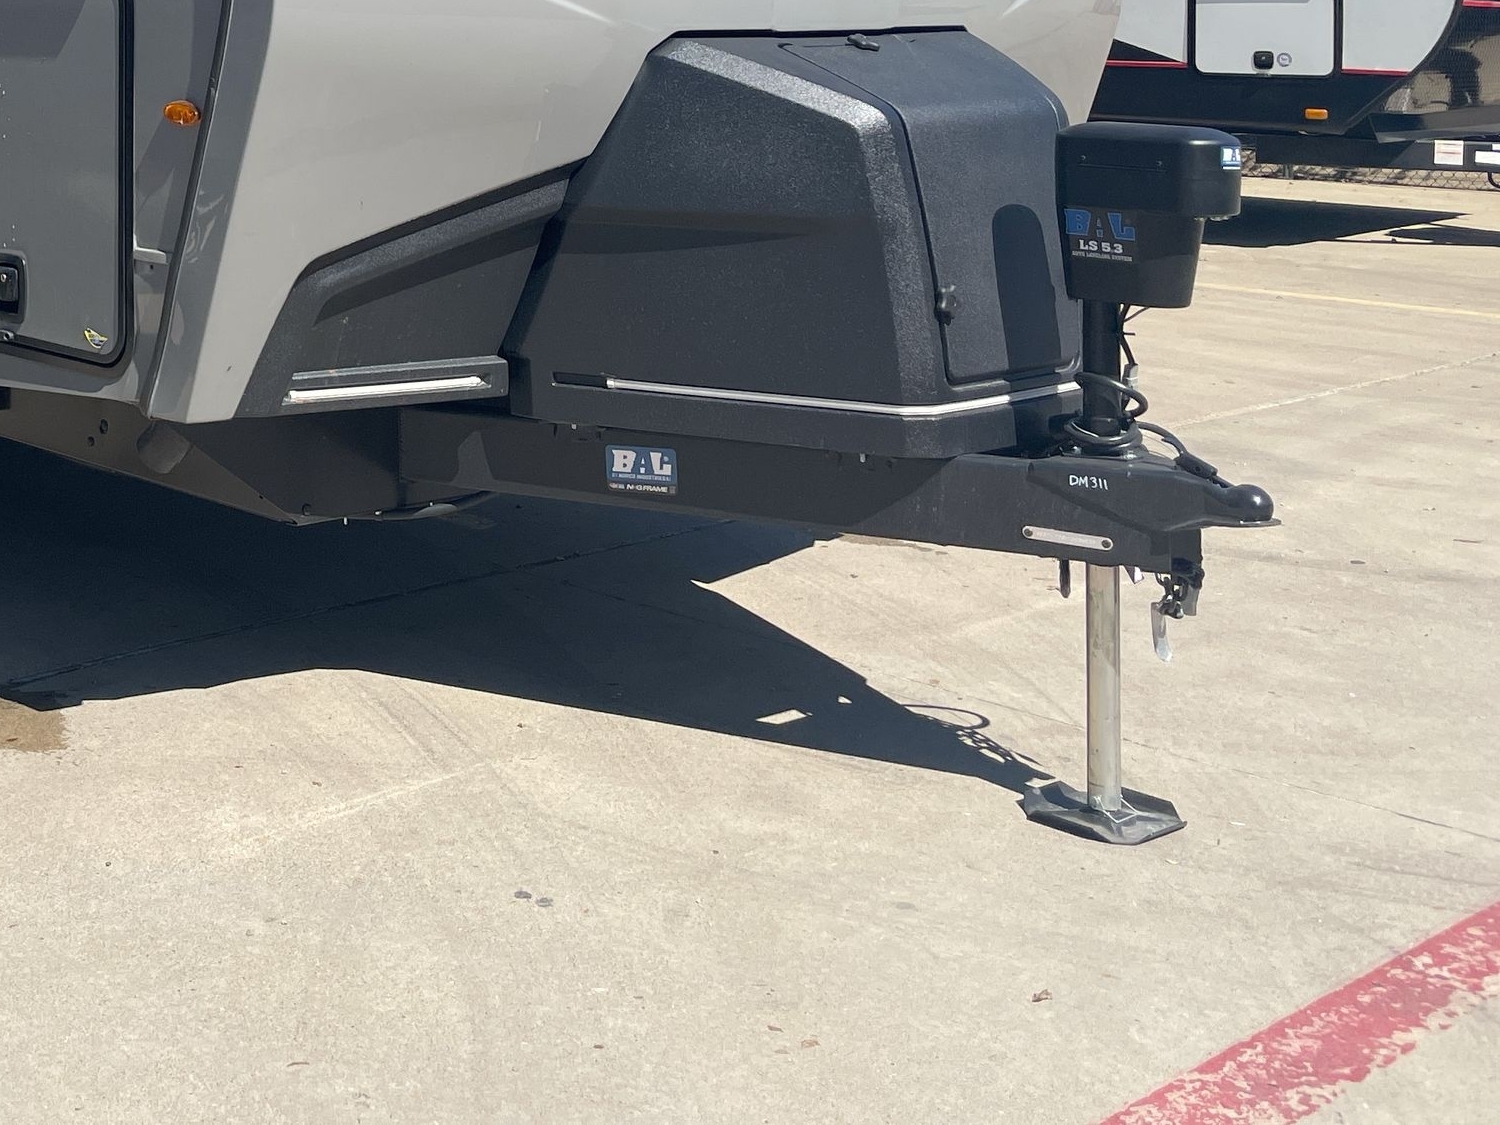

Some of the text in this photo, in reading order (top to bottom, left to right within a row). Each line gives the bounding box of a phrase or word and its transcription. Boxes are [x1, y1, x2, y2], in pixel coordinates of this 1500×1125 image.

[1079, 239, 1123, 254] LS 5.3
[612, 449, 672, 475] BAL
[1069, 475, 1108, 490] DM311
